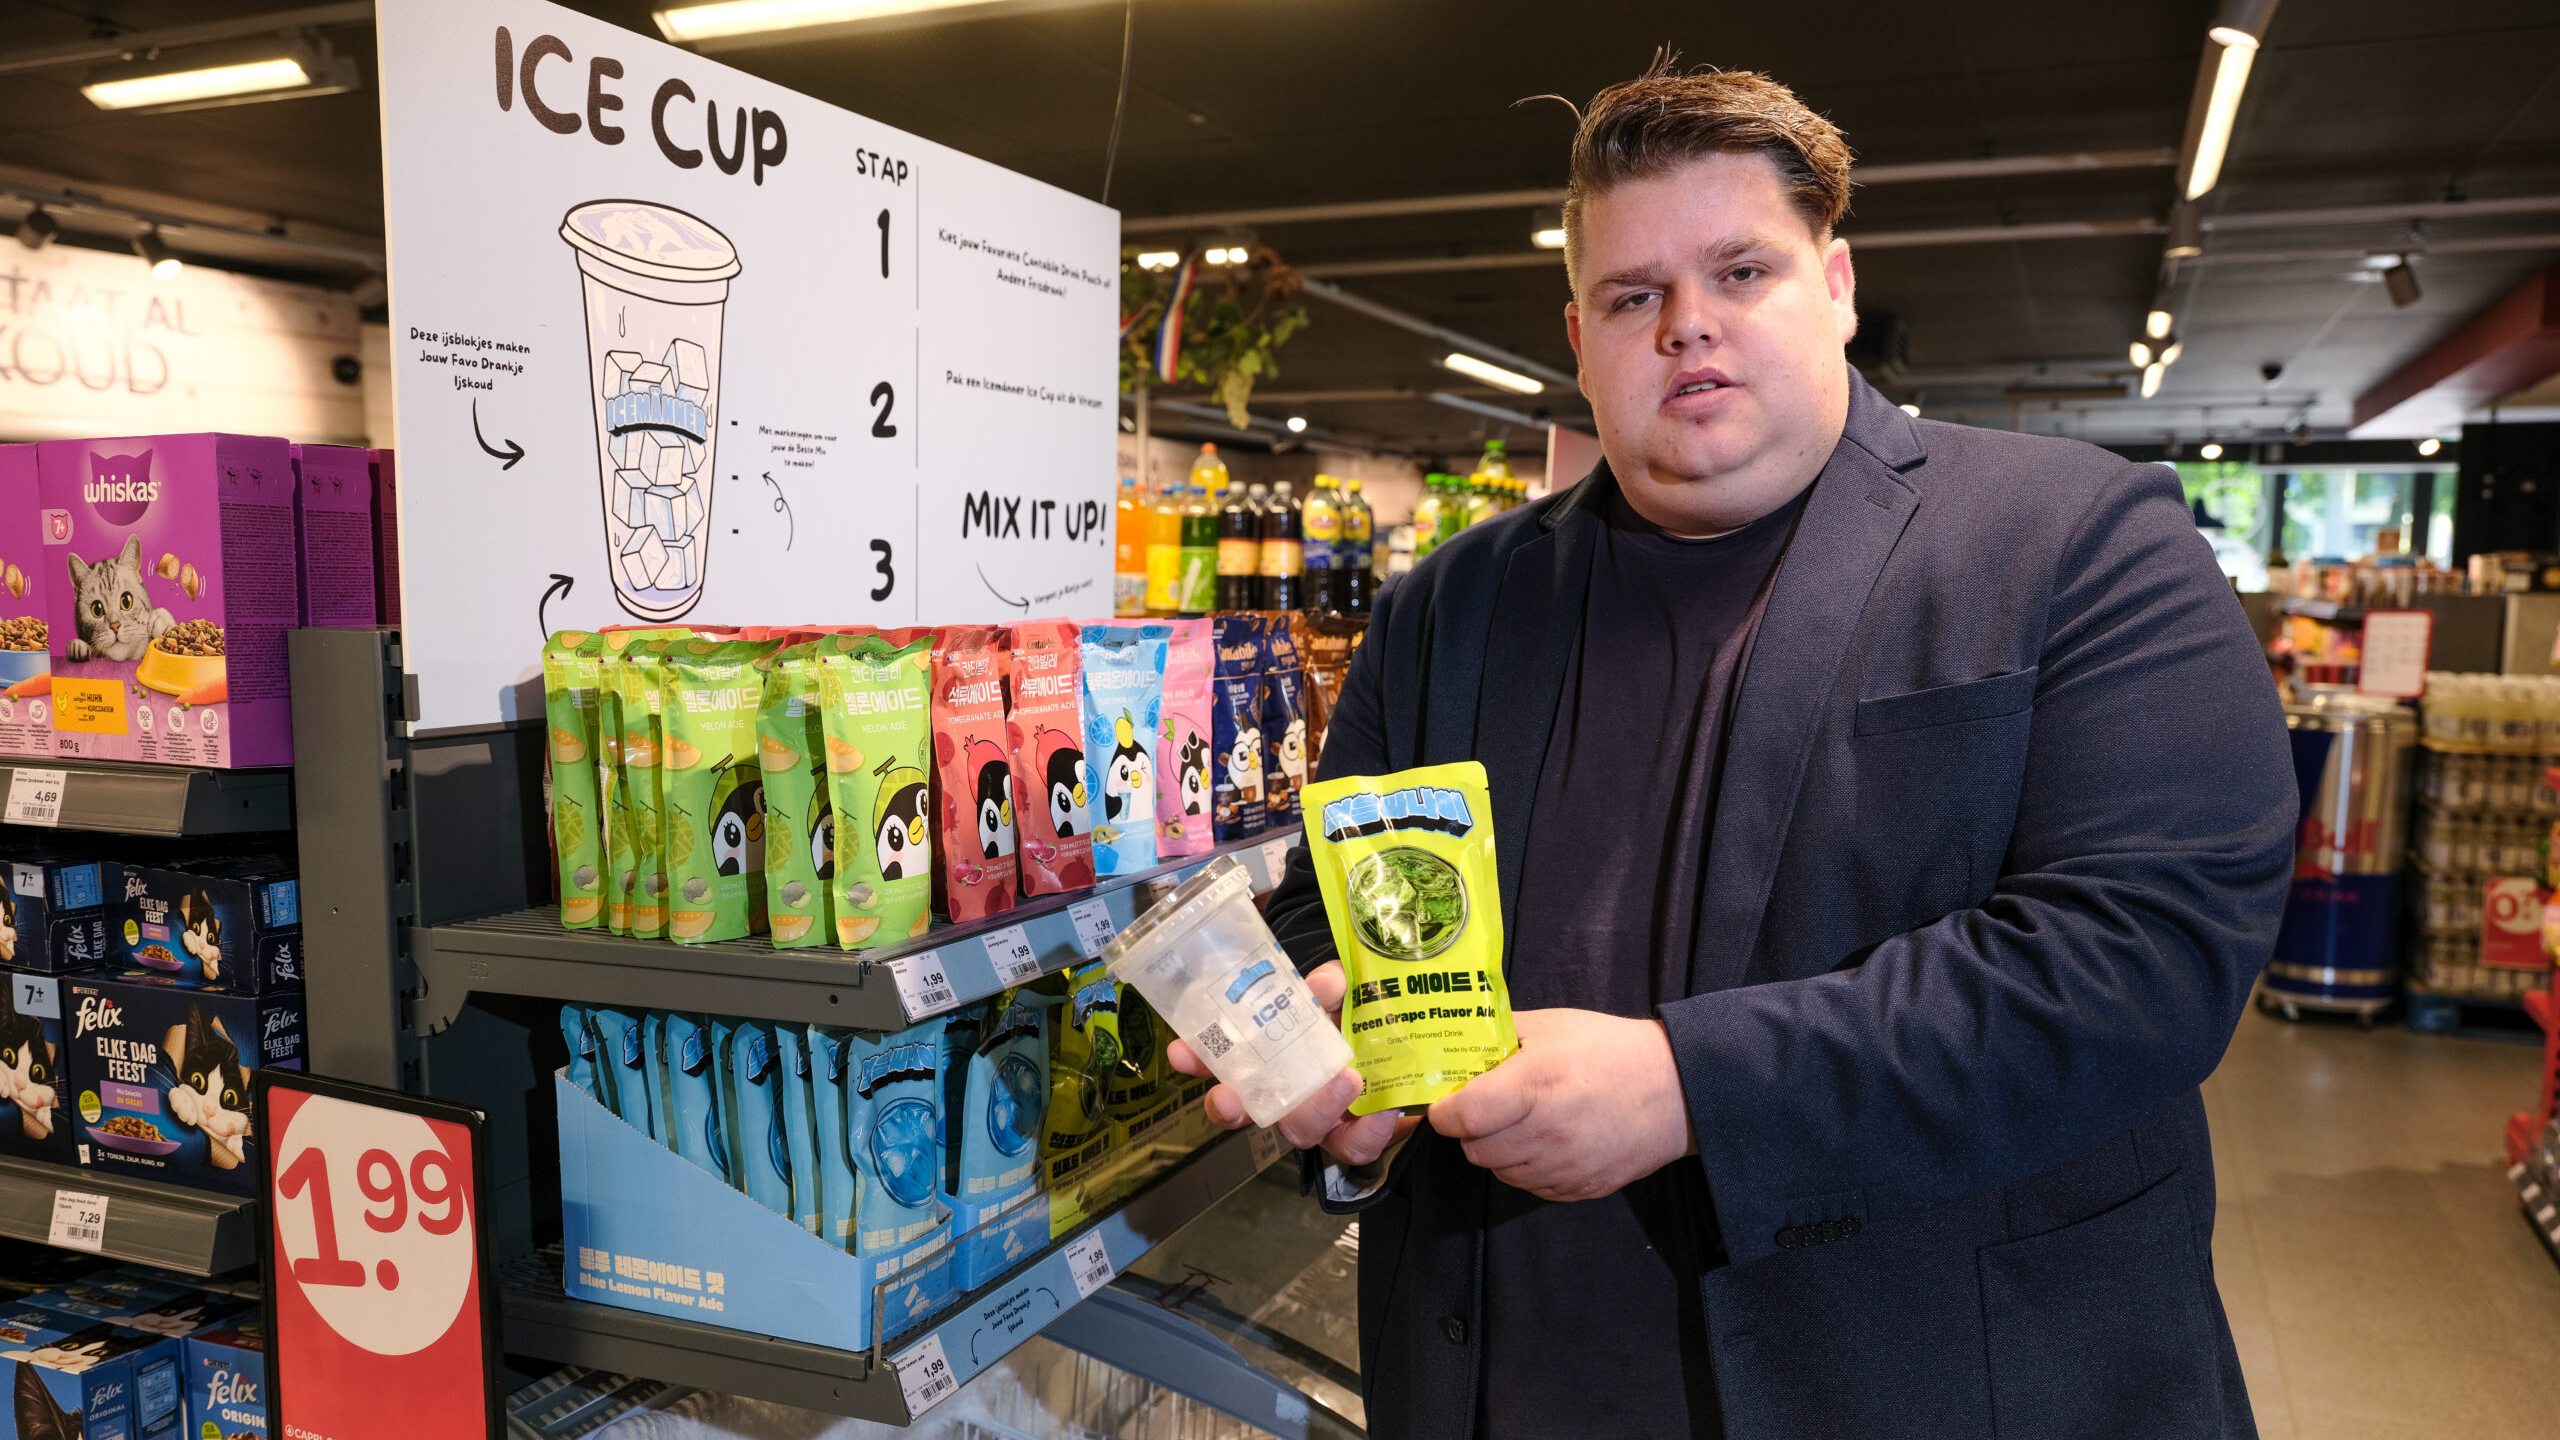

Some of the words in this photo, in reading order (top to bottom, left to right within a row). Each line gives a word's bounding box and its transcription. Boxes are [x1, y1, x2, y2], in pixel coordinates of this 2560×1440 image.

[495, 26, 625, 146] ICE
[652, 78, 788, 187] CUP
[856, 147, 909, 187] STAP
[877, 208, 890, 280] 1
[938, 228, 957, 246] Kies
[958, 235, 980, 251] jouw
[982, 239, 1020, 263] Favoriete
[1061, 263, 1080, 281] Drink
[997, 268, 1027, 288] Andere
[142, 296, 201, 338] AL
[410, 327, 438, 342] Deze
[441, 331, 493, 351] ijsblokjes
[496, 340, 531, 354] maken
[419, 351, 448, 366] Jouw
[451, 354, 478, 368] Favo
[481, 357, 524, 375] Drankje
[946, 370, 963, 386] Pak
[965, 377, 981, 389] een
[1026, 385, 1038, 398] Ice
[1039, 386, 1055, 405] Cup
[869, 381, 897, 438] 2
[759, 425, 773, 436] Met
[773, 429, 813, 442] markeringen
[770, 443, 786, 453] jouw
[796, 444, 814, 454] Beste
[784, 459, 791, 467] te
[792, 460, 815, 469] maken!
[84, 474, 159, 504] whiskas
[54, 519, 66, 535] 7+
[962, 489, 1021, 540] MIX
[1031, 498, 1056, 541] IT
[1066, 499, 1107, 547] UP!
[869, 538, 895, 602] 3
[850, 662, 902, 684] 칸타빌레
[947, 680, 1003, 708] 석류에이드
[1020, 674, 1073, 700] 석류에이드
[682, 687, 761, 713] 멜론에이드
[843, 687, 924, 716] 멜론에이드
[1061, 700, 1077, 710] ADE
[700, 721, 727, 731] MELON
[728, 719, 745, 729] ADE
[862, 723, 888, 733] MELON
[889, 721, 908, 731] ADE
[947, 711, 993, 724] POMEGRANATE
[59, 739, 74, 750] 800
[74, 741, 79, 752] g
[35, 790, 57, 804] 4,69
[125, 877, 149, 902] felix
[140, 897, 156, 912] ELKE
[145, 910, 165, 924] FEEST
[1095, 918, 1111, 932] 1,99
[67, 923, 94, 961] felix
[93, 938, 104, 960] ELKE
[1011, 944, 1030, 960] 1,99
[275, 941, 301, 981] felix
[923, 972, 944, 988] 1,99
[1406, 971, 1473, 995] 에이드
[24, 984, 44, 1005] 7+
[75, 996, 124, 1039] felix
[264, 1009, 299, 1040] felix
[1265, 1005, 1300, 1042] CUP
[1352, 1016, 1383, 1034] Green
[1385, 1010, 1426, 1023] Grape
[1429, 1006, 1473, 1019] Flavor
[264, 1036, 284, 1051] ELKE
[284, 1034, 300, 1046] DAG
[1387, 1035, 1408, 1045] Grape
[1410, 1031, 1442, 1040] Flavored
[1444, 1029, 1464, 1038] Drink
[96, 1036, 129, 1061] ELKE
[129, 1041, 157, 1065] DAG
[271, 1044, 295, 1059] FEEST
[108, 1059, 148, 1084] FEEST
[79, 1211, 101, 1225] 7,29
[278, 1146, 465, 1291] 1.99
[1089, 1248, 1104, 1265] 1,99
[579, 1246, 611, 1273] 블루
[614, 1254, 702, 1291] 레몬에이드
[705, 1271, 725, 1296] 맛
[579, 1272, 607, 1289] Blue
[608, 1278, 652, 1299] Lemon
[653, 1287, 696, 1307] Flavor
[698, 1295, 725, 1312] Ade
[984, 1308, 996, 1321] Deze
[924, 1358, 945, 1378] 1,99
[91, 1380, 125, 1414] felix
[206, 1369, 258, 1411] felix
[89, 1403, 127, 1422] ORIGINAL
[221, 1407, 267, 1429] ORIGIN
